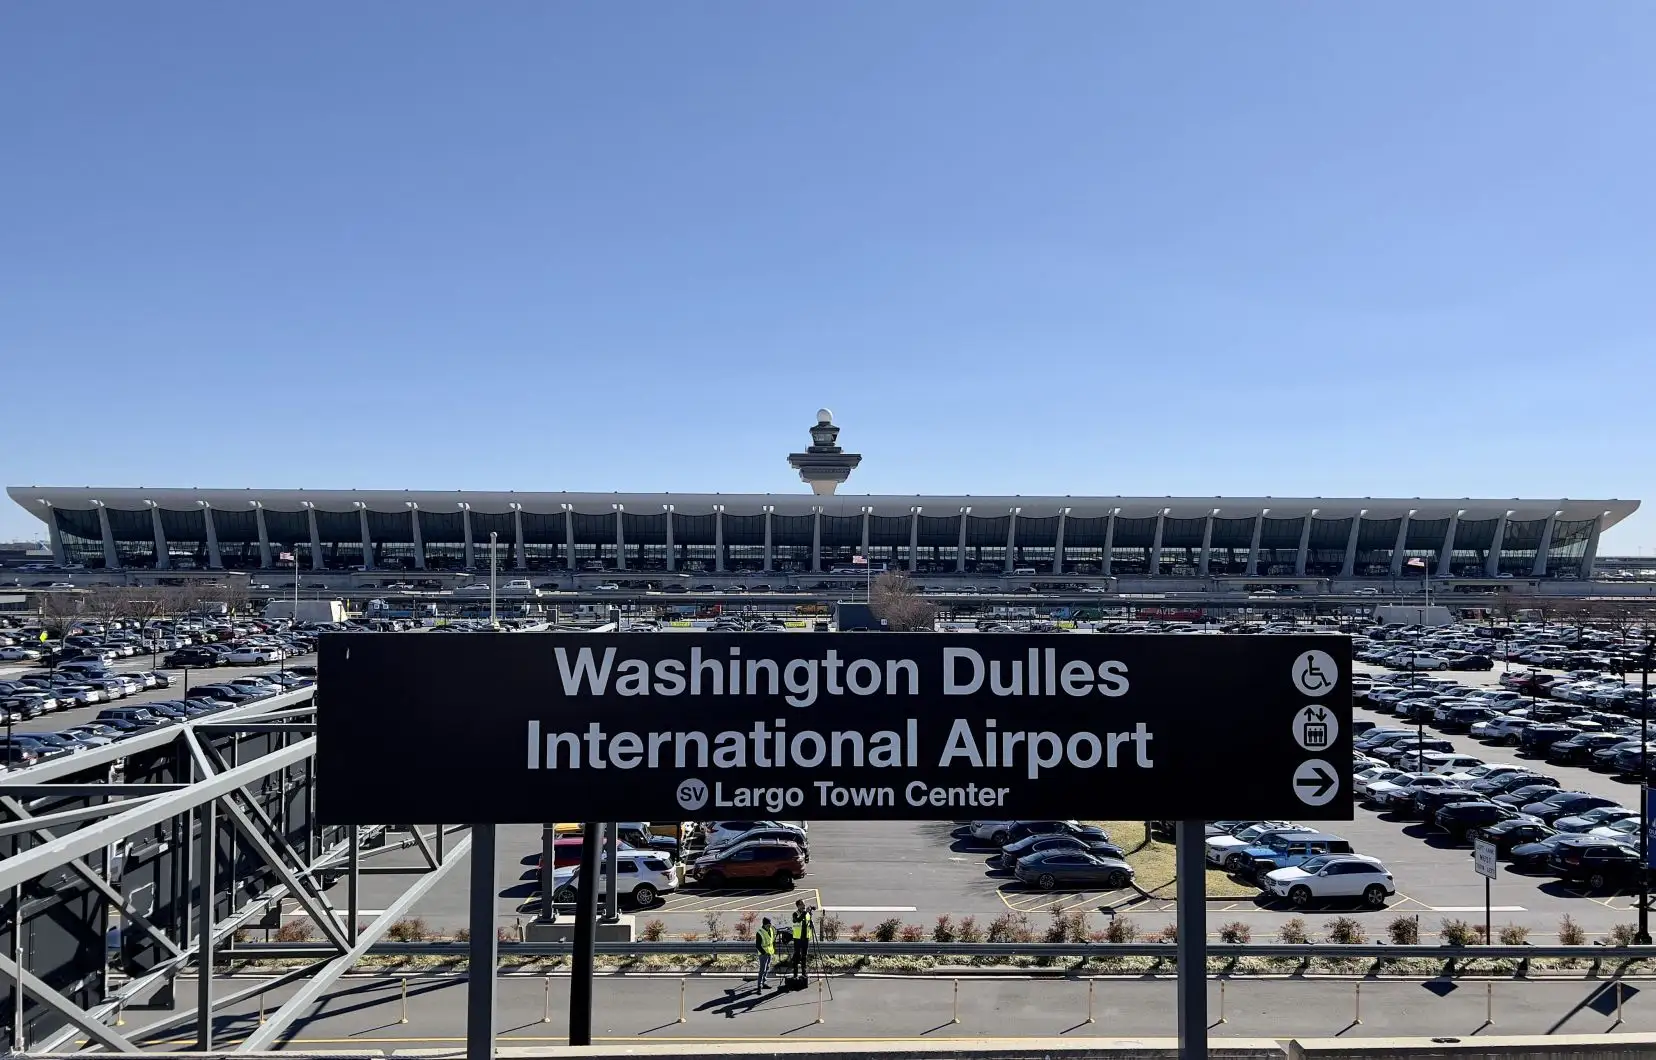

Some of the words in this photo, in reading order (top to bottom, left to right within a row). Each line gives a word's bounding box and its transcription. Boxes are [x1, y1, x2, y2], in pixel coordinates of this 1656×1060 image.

[554, 647, 919, 707] Washington
[944, 647, 1130, 697] Dulles
[528, 719, 918, 769] International
[939, 719, 1154, 780] Airport
[680, 786, 705, 802] SV
[716, 781, 804, 812] Largo
[813, 781, 895, 807] Town
[906, 780, 1010, 807] Center
